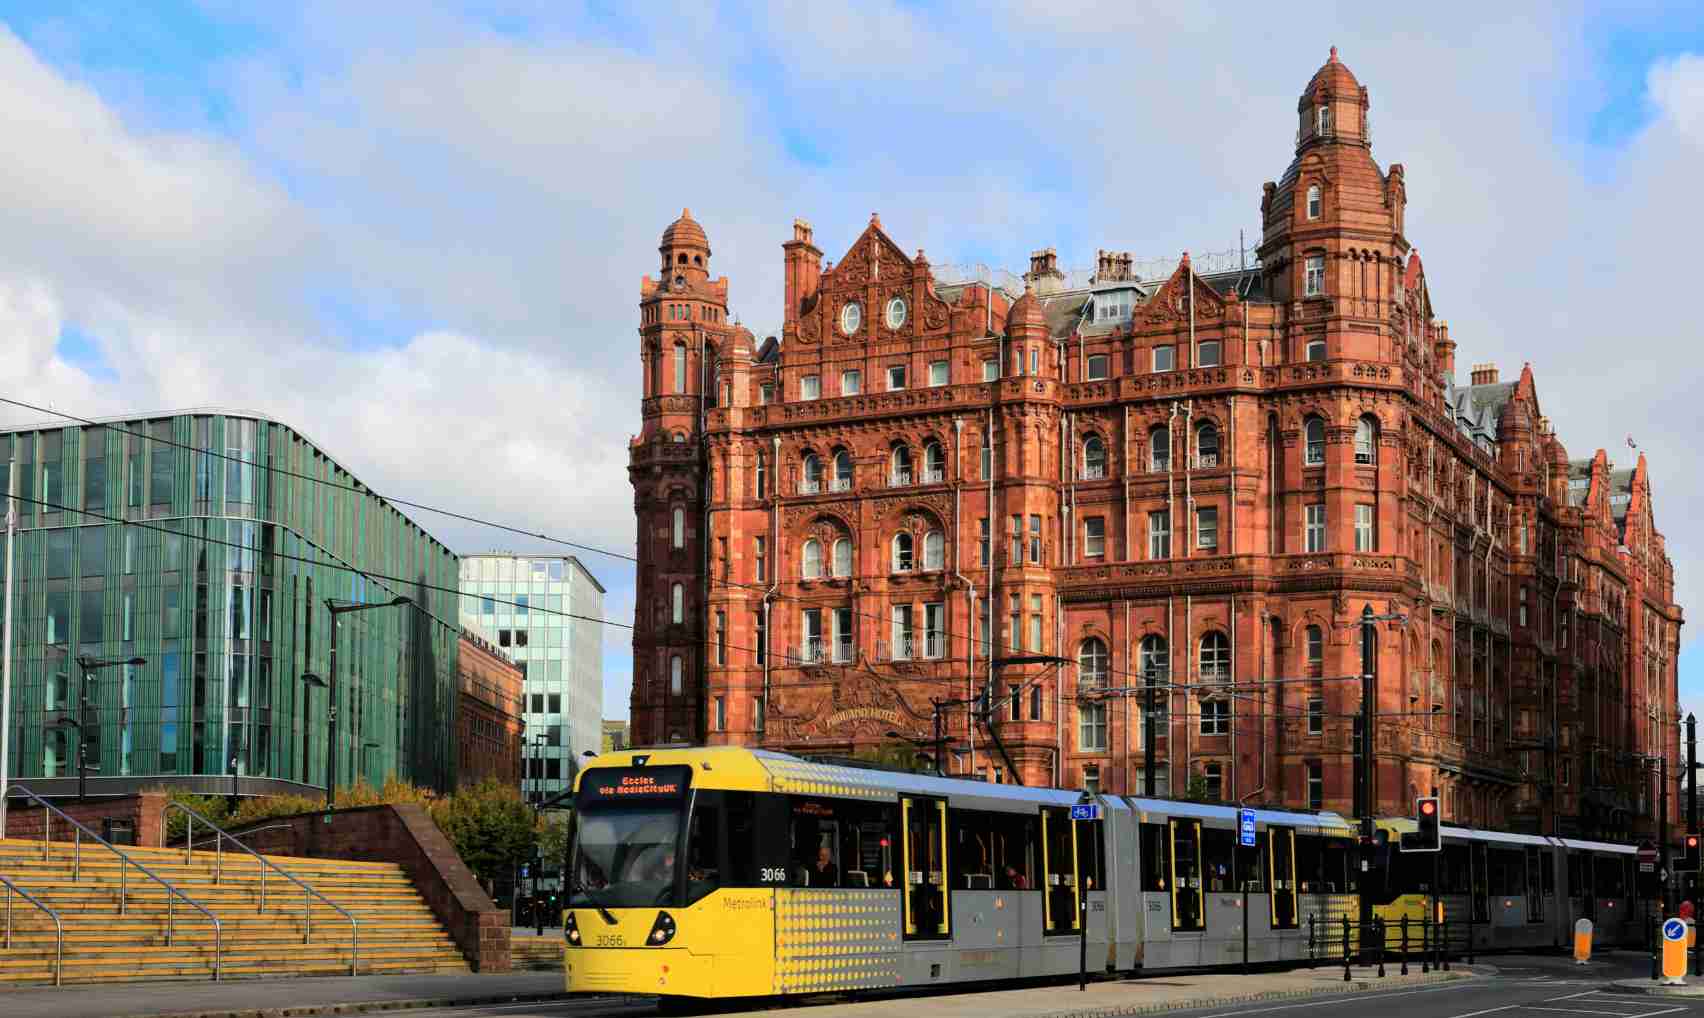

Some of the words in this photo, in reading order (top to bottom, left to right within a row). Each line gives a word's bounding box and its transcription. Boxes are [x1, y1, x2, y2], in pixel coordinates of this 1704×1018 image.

[622, 776, 655, 785] Eccles
[761, 867, 786, 881] 3066
[597, 935, 623, 946] 3066
